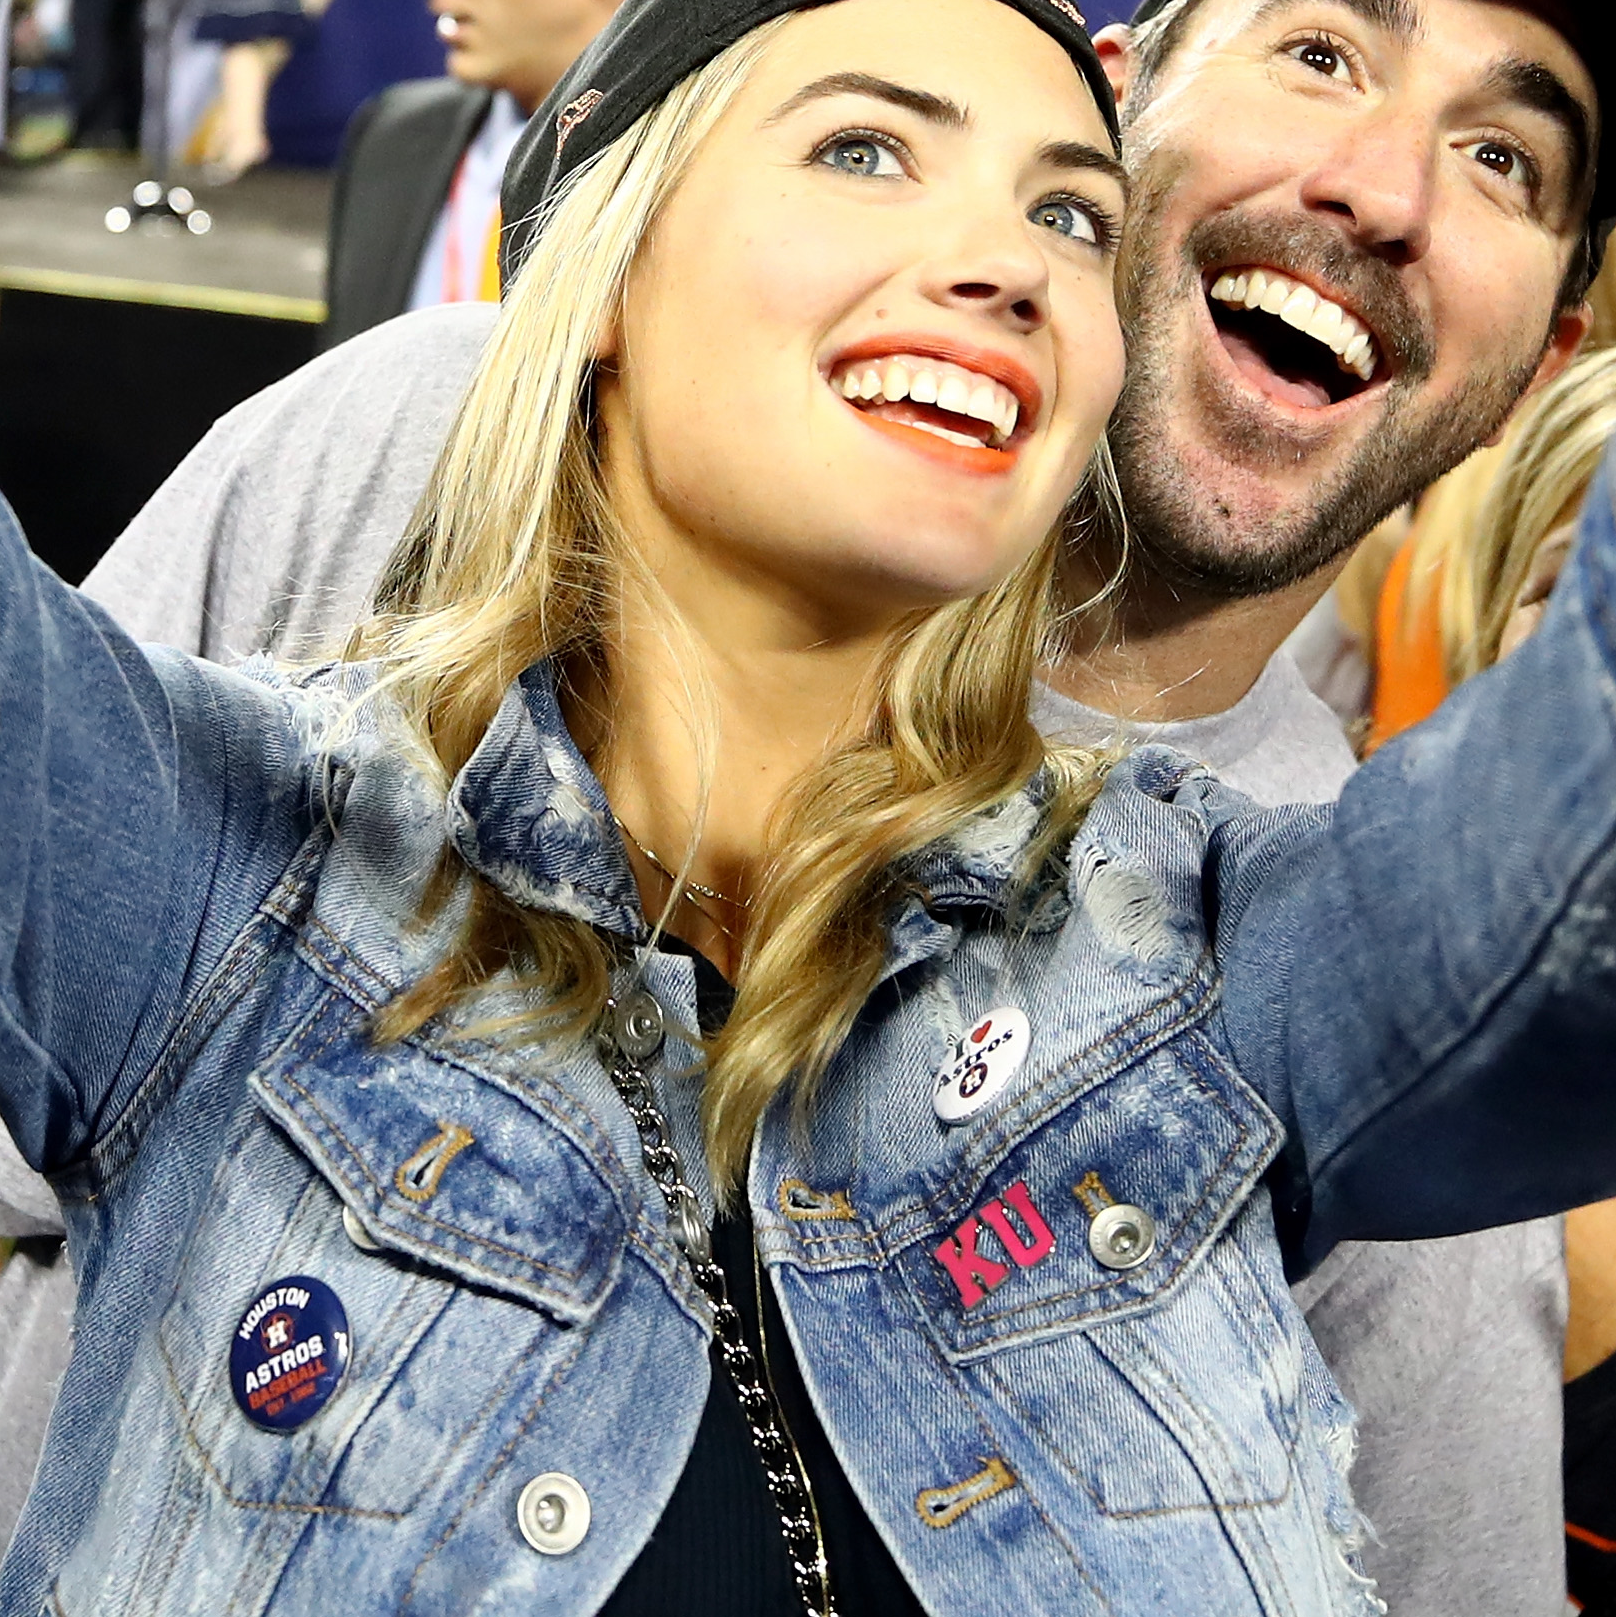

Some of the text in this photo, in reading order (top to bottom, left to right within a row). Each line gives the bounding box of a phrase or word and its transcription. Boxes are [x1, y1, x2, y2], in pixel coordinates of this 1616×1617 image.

[935, 1028, 1014, 1096] Astros
[933, 1180, 1058, 1311] KU
[238, 1286, 311, 1341] HOUSTON
[245, 1334, 325, 1394] ASTROS
